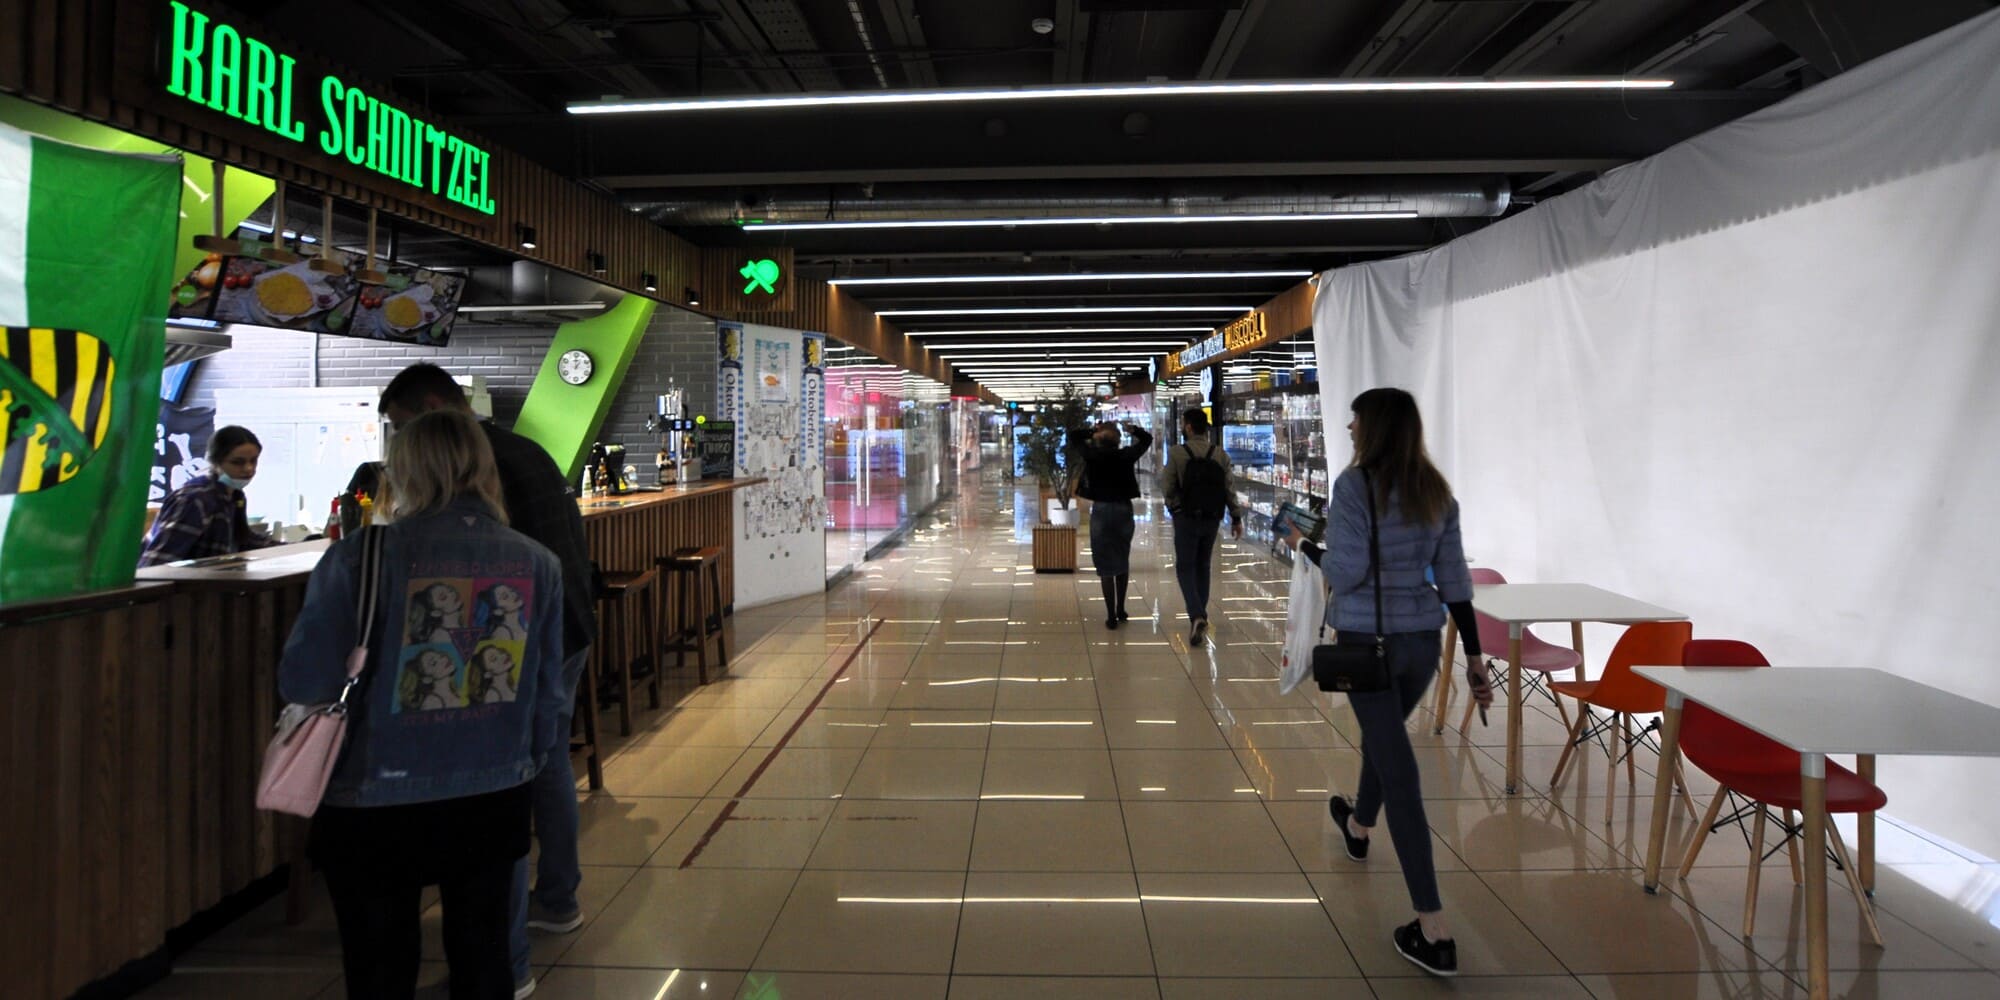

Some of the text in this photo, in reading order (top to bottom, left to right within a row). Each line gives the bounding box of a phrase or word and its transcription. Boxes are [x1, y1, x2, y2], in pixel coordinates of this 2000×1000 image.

[166, 0, 495, 215] KARL SCHNITZEL
[726, 373, 736, 422] Oktobe
[808, 379, 817, 449] Oktoberfest
